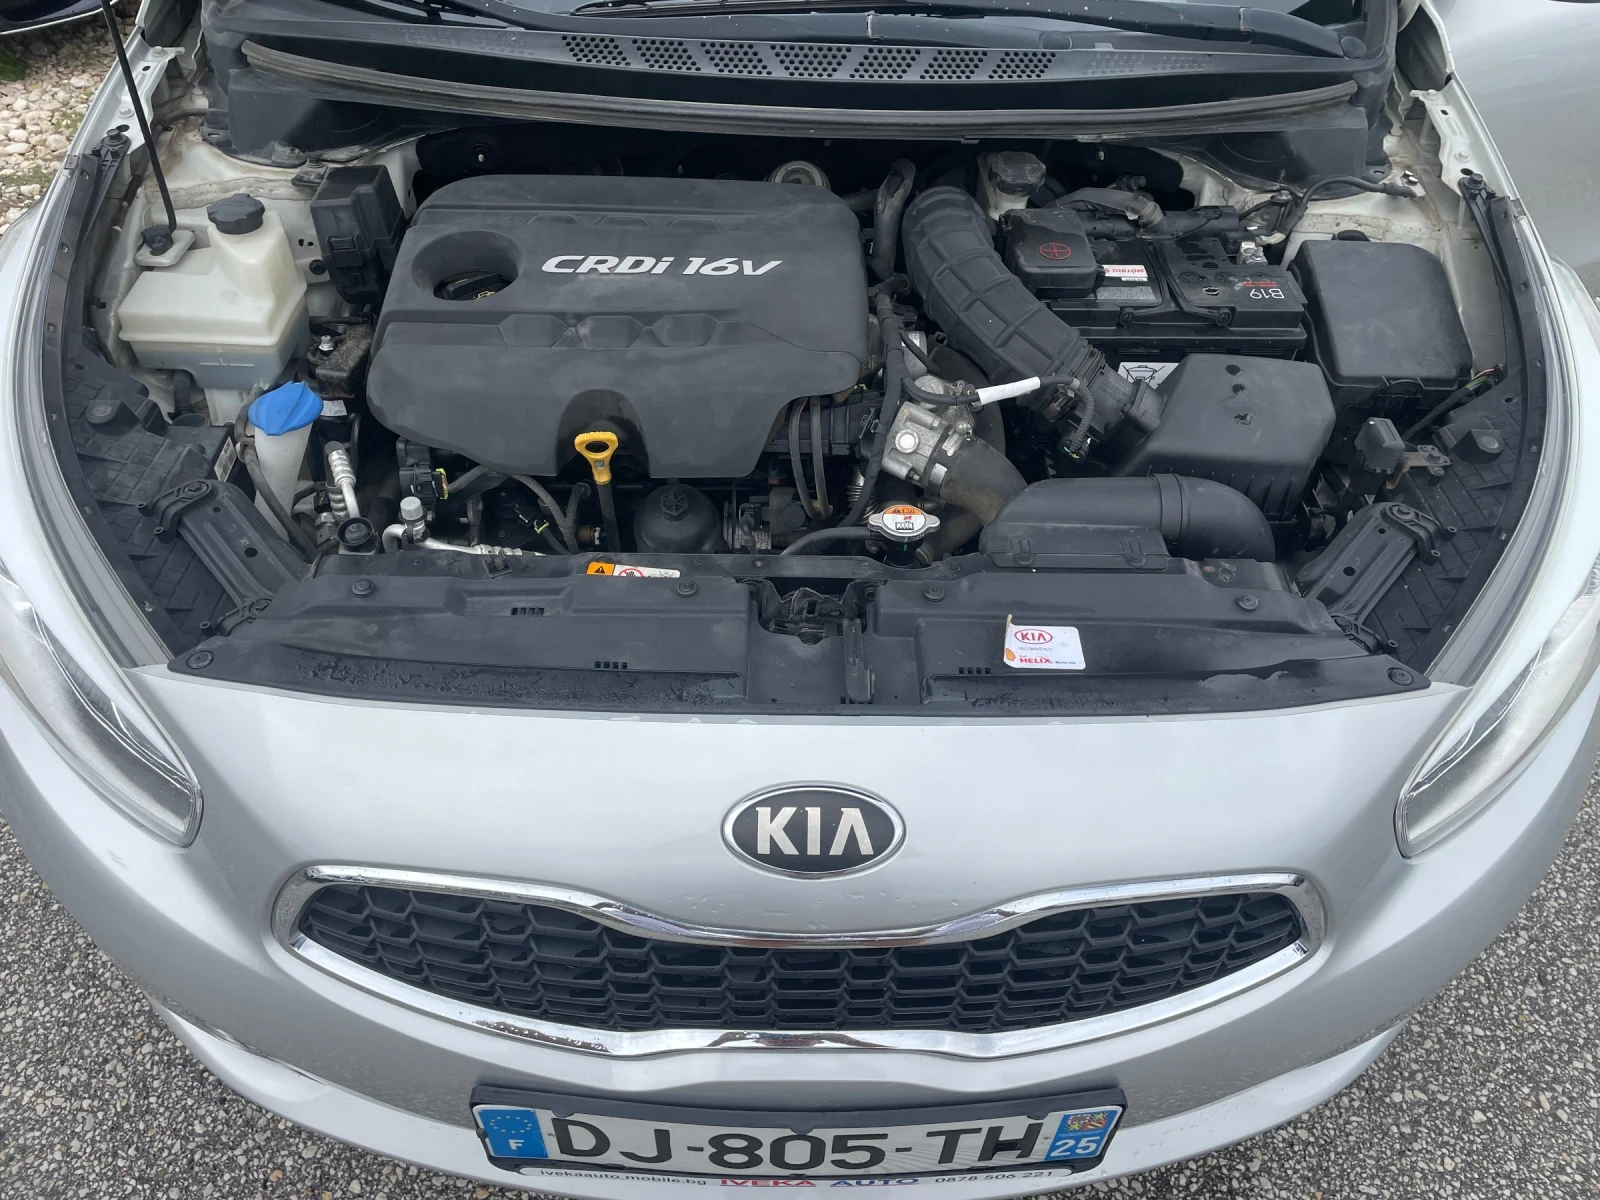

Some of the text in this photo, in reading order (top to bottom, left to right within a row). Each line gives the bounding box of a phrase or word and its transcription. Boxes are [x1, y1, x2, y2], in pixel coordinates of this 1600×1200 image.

[541, 255, 783, 276] CRDi 16V
[1250, 288, 1285, 299] B19
[1020, 632, 1047, 641] KIA
[756, 807, 874, 856] KIA
[509, 1139, 524, 1150] F
[552, 1117, 1044, 1171] DJ-805-TH
[1050, 1136, 1100, 1157] 25
[540, 1169, 707, 1186] ivekaauto.mobile.bg
[830, 1178, 920, 1186] AUTO
[935, 1175, 978, 1183] 0878
[1022, 1170, 1052, 1179] 221
